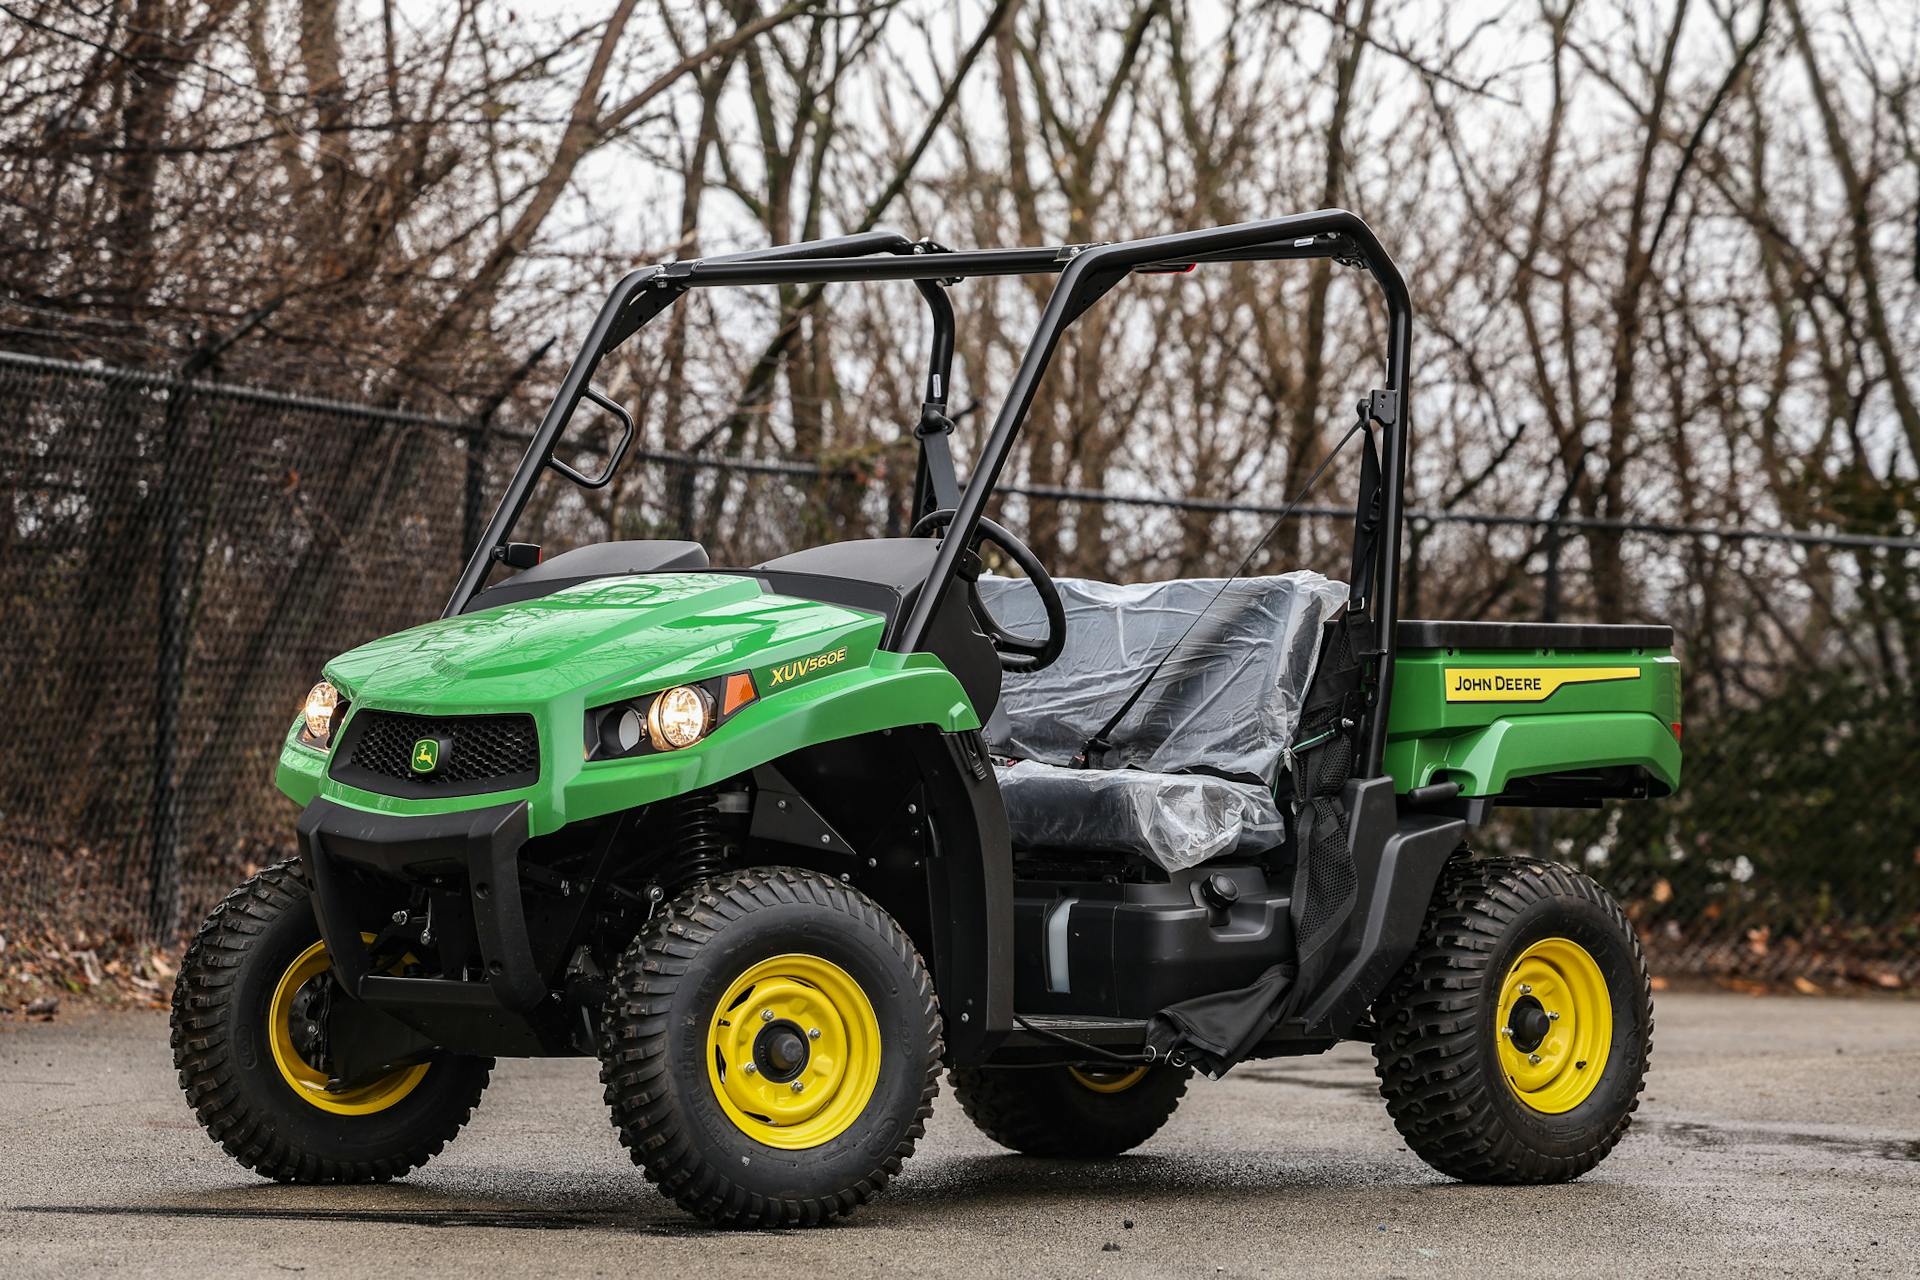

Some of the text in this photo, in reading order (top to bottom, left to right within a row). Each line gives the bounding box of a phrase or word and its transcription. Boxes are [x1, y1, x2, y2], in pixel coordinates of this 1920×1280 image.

[769, 648, 846, 687] XUV560E
[1455, 676, 1542, 691] JOHN DEERE
